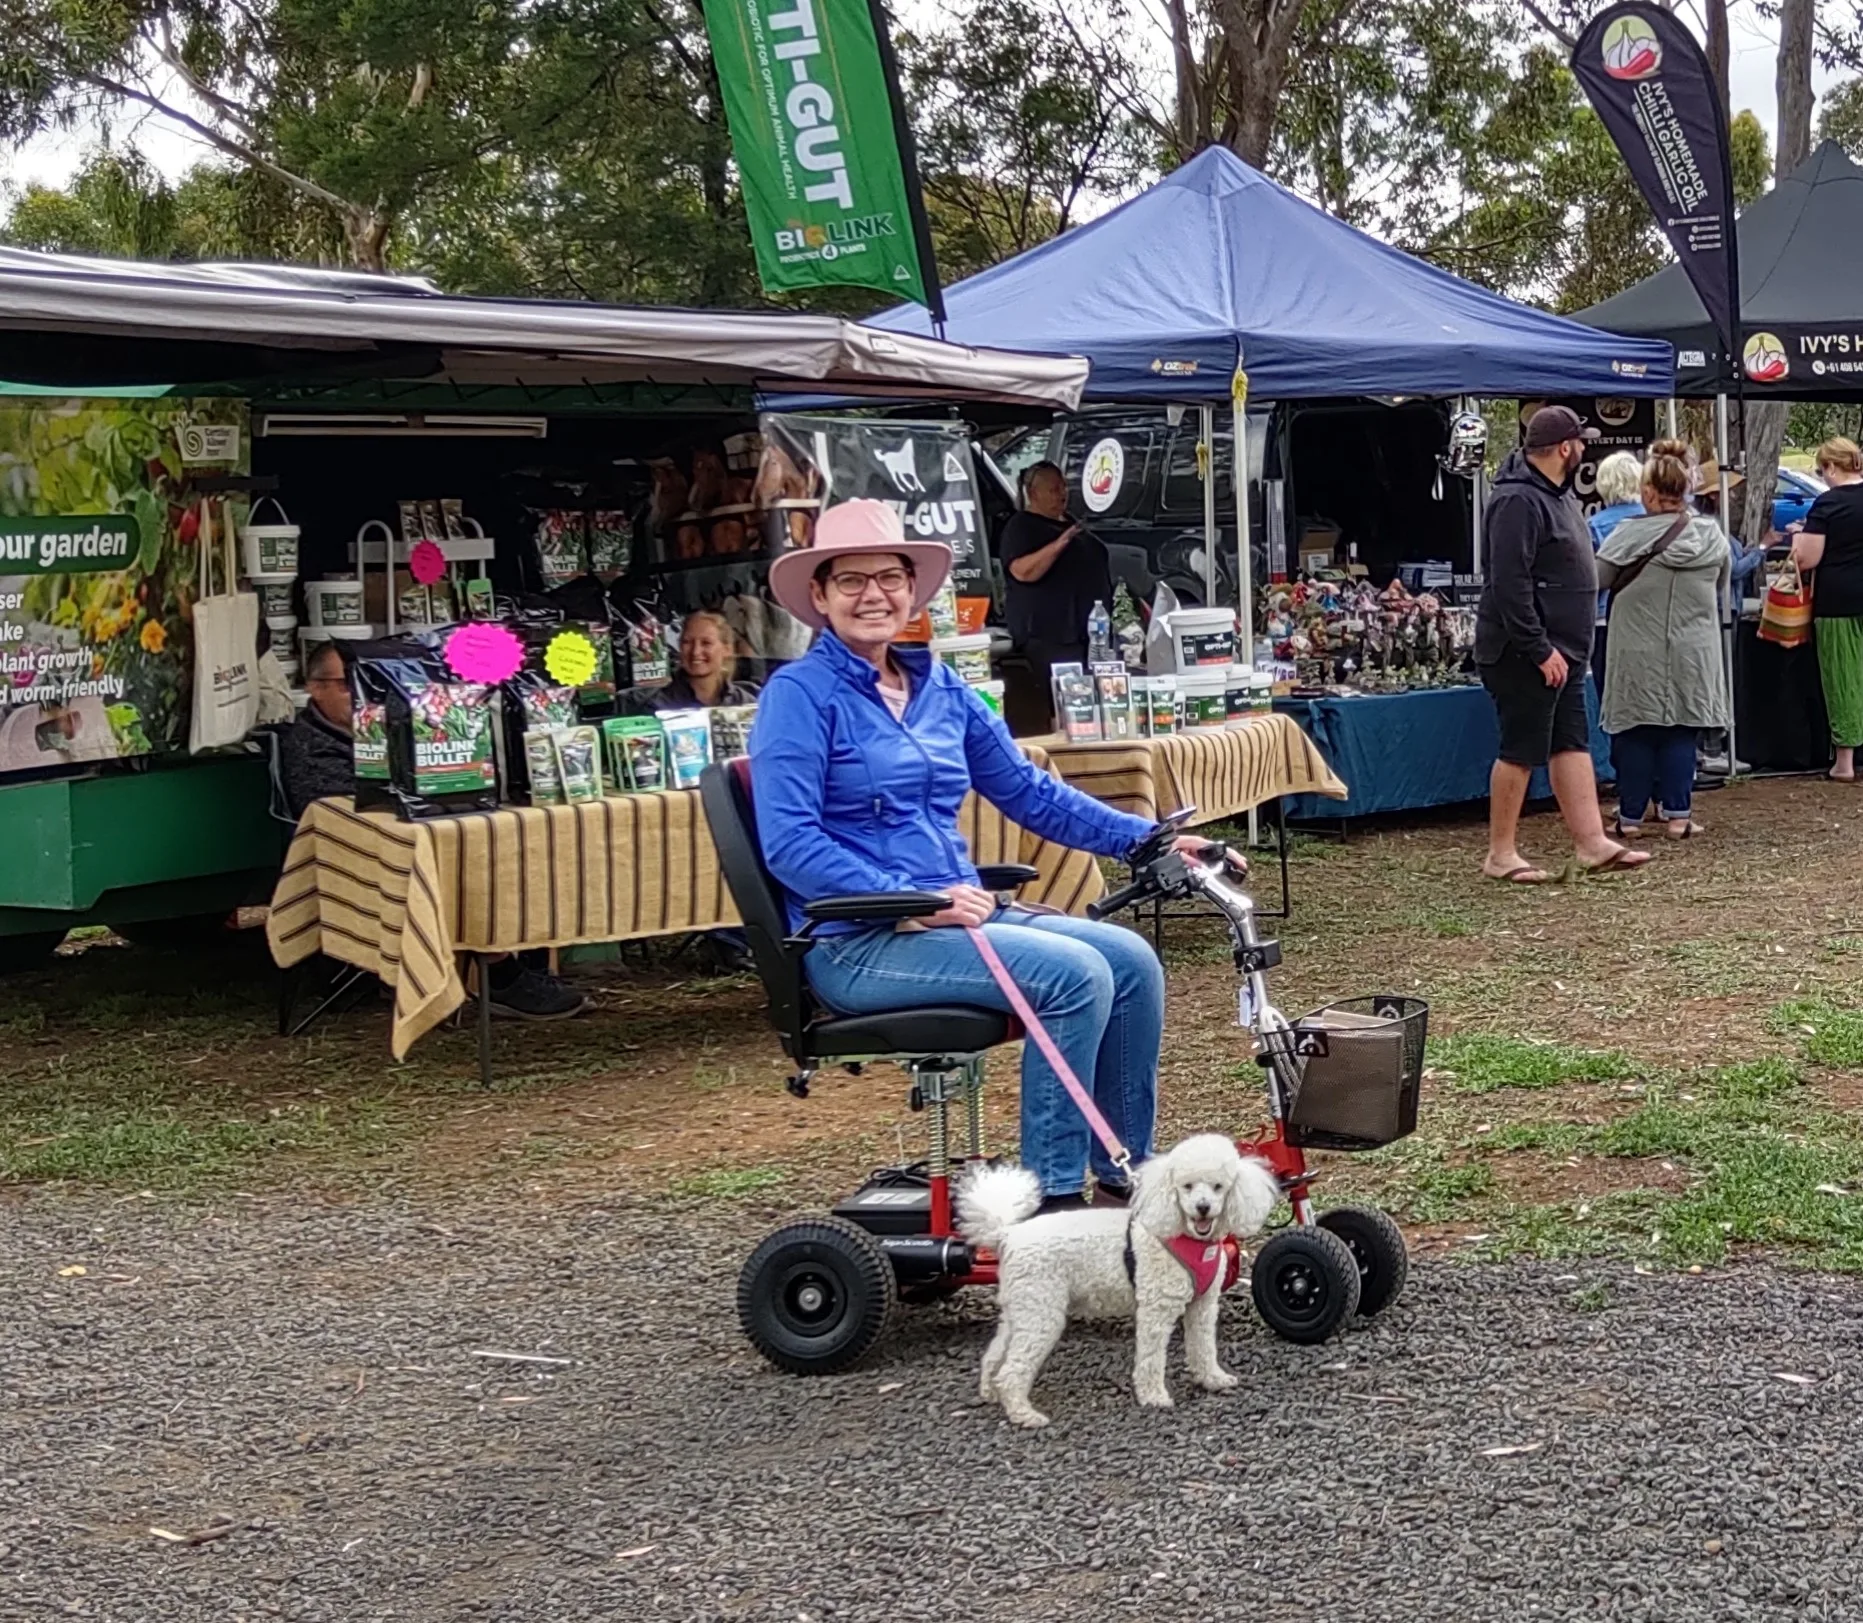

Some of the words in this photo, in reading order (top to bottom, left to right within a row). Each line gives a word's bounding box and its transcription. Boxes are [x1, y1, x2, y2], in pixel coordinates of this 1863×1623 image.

[757, 44, 769, 66] FOR
[763, 69, 780, 116] OPTIMUM
[772, 118, 788, 158] ANIMAL
[783, 159, 797, 200] HEALTH
[1638, 82, 1666, 129] CHILLI
[1658, 129, 1689, 185] GARLIC
[1681, 185, 1699, 213] OIL
[1652, 82, 1674, 118] IVY'S
[1668, 118, 1708, 200] HOMEMADE
[1800, 335, 1850, 354] IVY'S
[1615, 436, 1634, 444] DAY
[1634, 436, 1643, 444] IS
[0, 534, 35, 560] ur
[38, 525, 128, 567] garden
[0, 620, 24, 641] ke
[0, 651, 36, 673] lant
[37, 646, 93, 675] growth
[11, 674, 124, 703] worm-friendly
[415, 739, 477, 755] BIOLINK
[416, 751, 474, 767] BULLET
